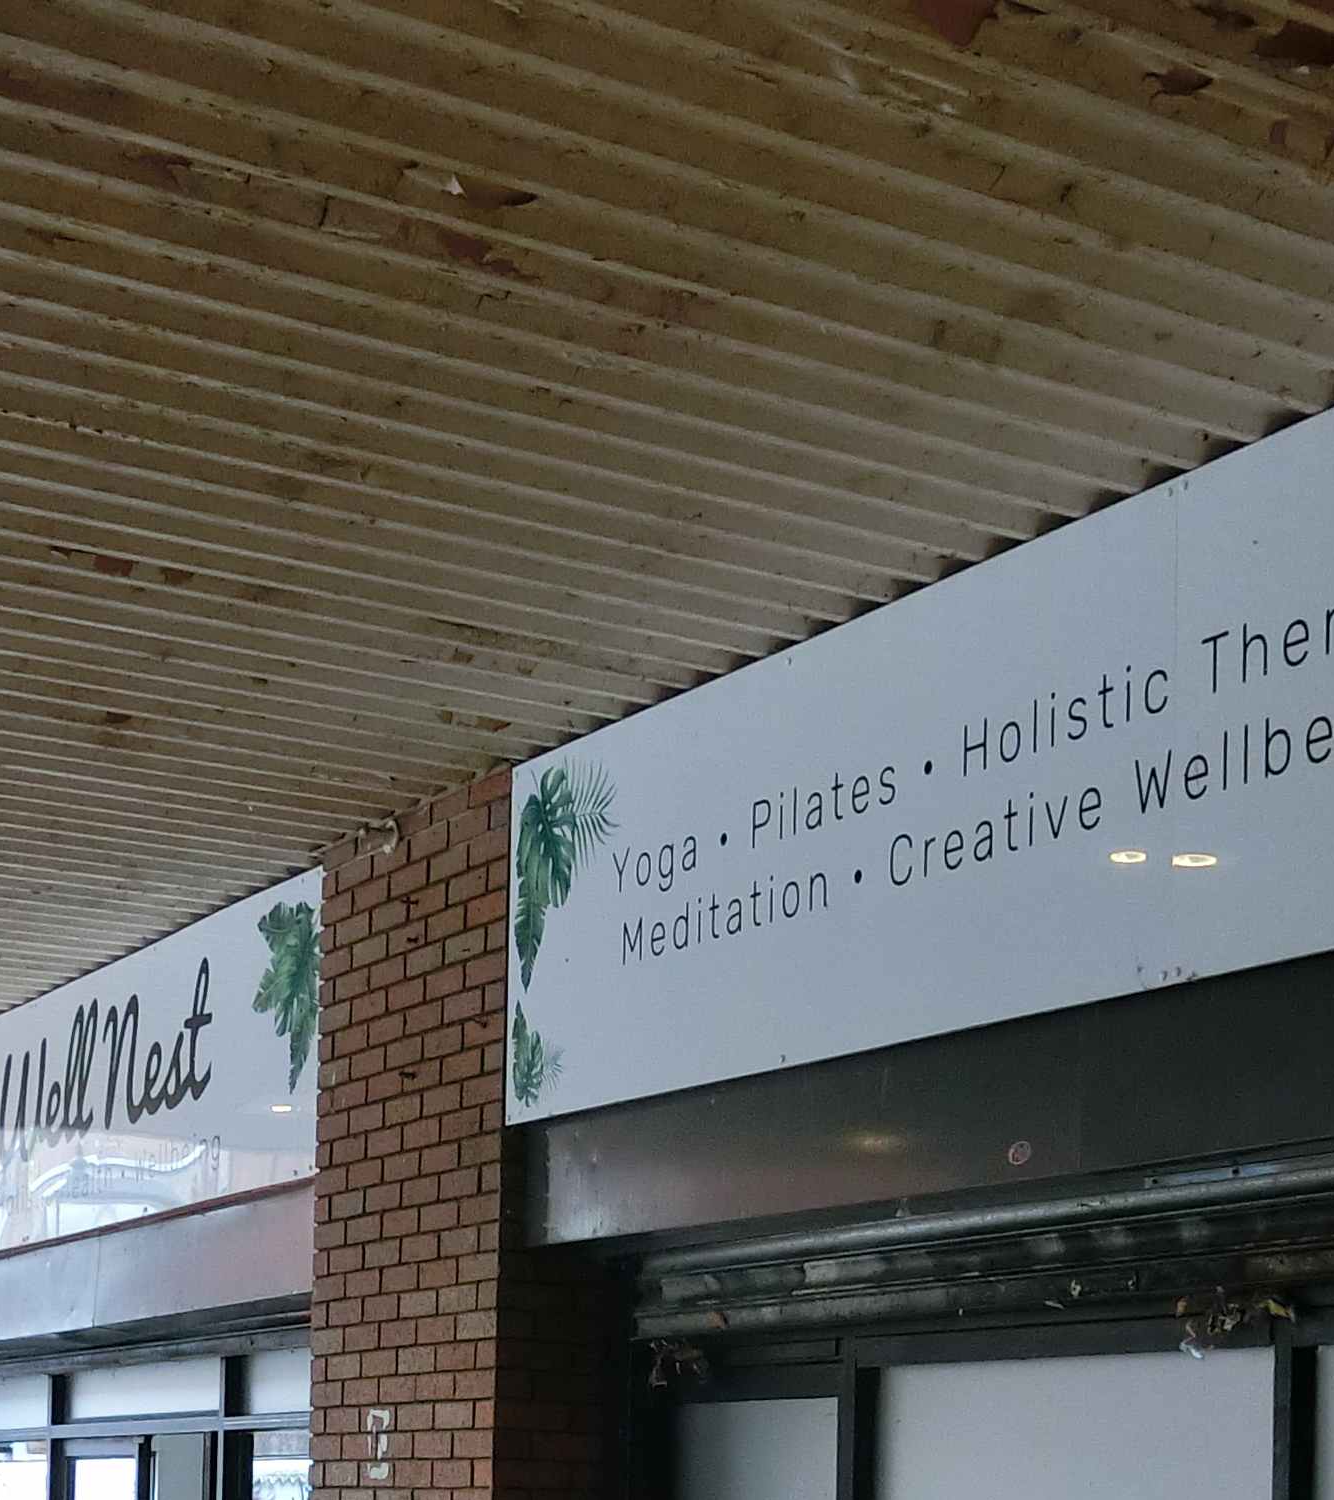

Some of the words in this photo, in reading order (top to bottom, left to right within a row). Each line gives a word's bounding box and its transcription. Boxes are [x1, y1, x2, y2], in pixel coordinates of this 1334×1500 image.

[612, 835, 697, 893] Yoga
[751, 765, 897, 849] Pilates
[963, 664, 1169, 778] Holistic
[622, 875, 828, 966] Meditation
[889, 786, 1103, 886] Creative
[102, 956, 213, 1130] Nest
